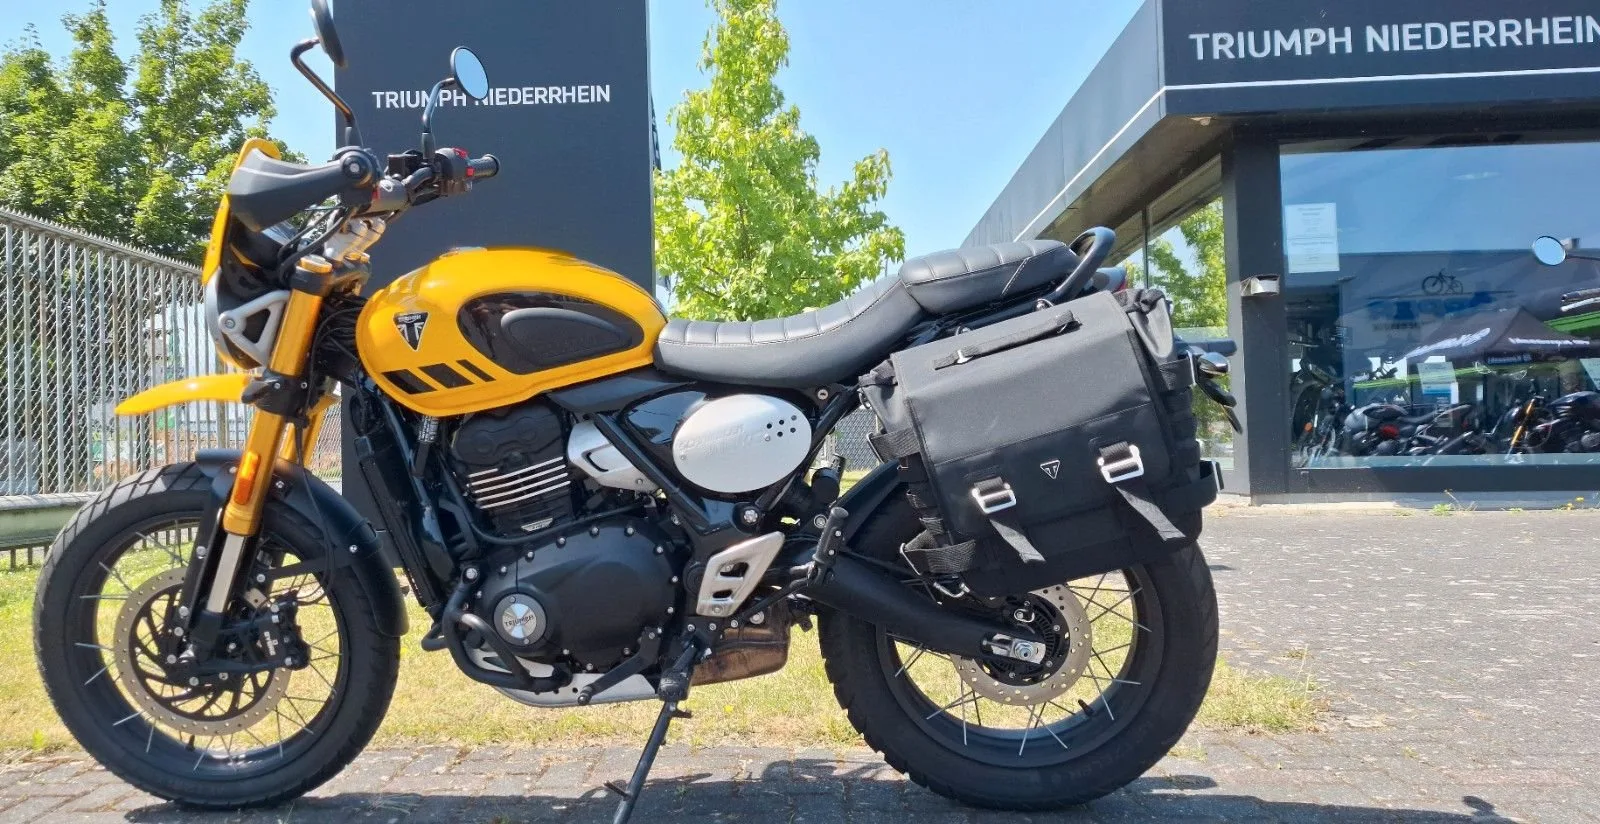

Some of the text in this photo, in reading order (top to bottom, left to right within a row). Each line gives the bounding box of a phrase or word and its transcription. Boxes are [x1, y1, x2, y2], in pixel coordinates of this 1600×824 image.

[1188, 15, 1600, 60] TRIUMPH NIEDERRHEIN
[475, 84, 611, 107] IEDERRHEIN
